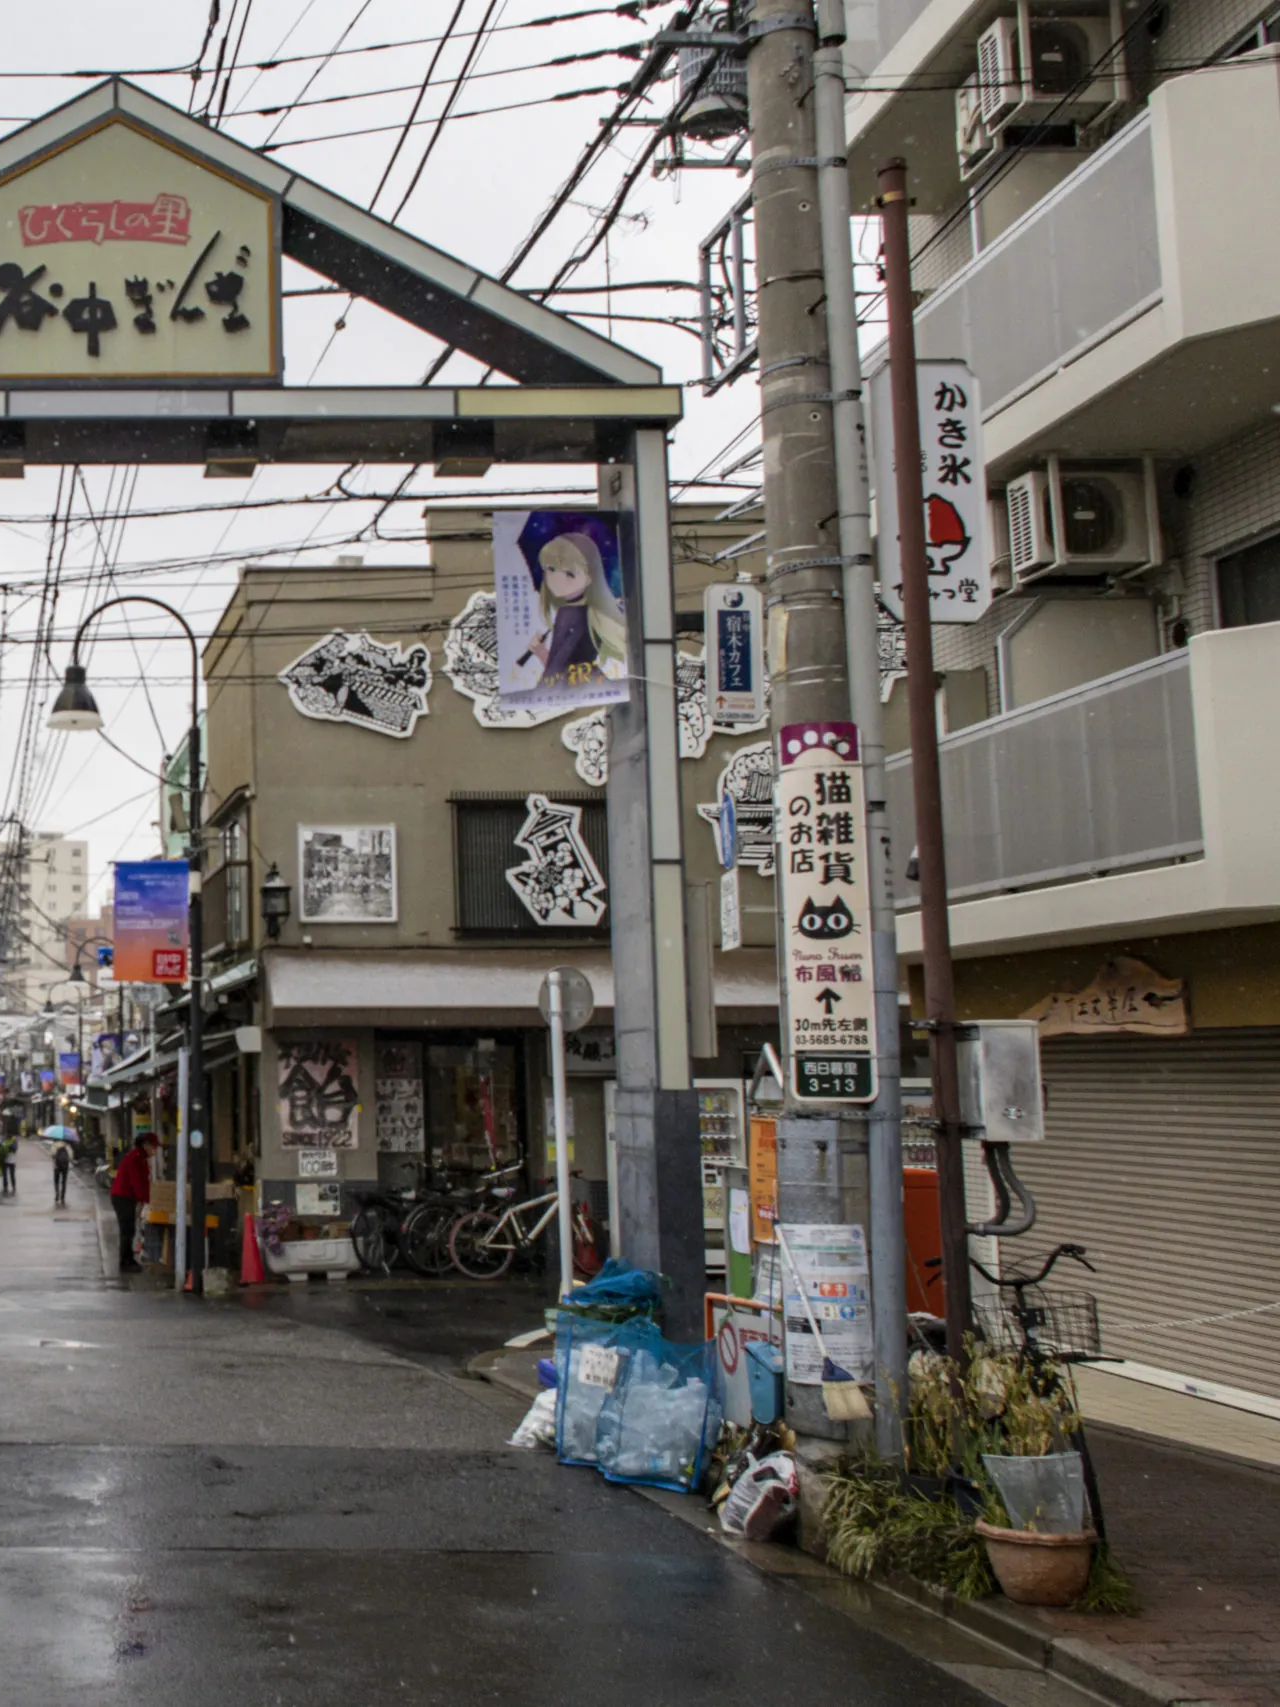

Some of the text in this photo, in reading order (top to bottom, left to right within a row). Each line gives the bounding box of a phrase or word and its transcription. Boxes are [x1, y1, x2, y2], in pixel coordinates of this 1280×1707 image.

[23, 195, 189, 246] ひぐらしの里
[933, 381, 972, 485] かき氷
[788, 796, 814, 874] のお店
[814, 771, 855, 886] 猫雑貨
[794, 1017, 868, 1032] 30m先左側
[278, 1059, 359, 1129] 飴
[803, 1061, 859, 1076] 西日暮里
[808, 1078, 856, 1092] 3-13
